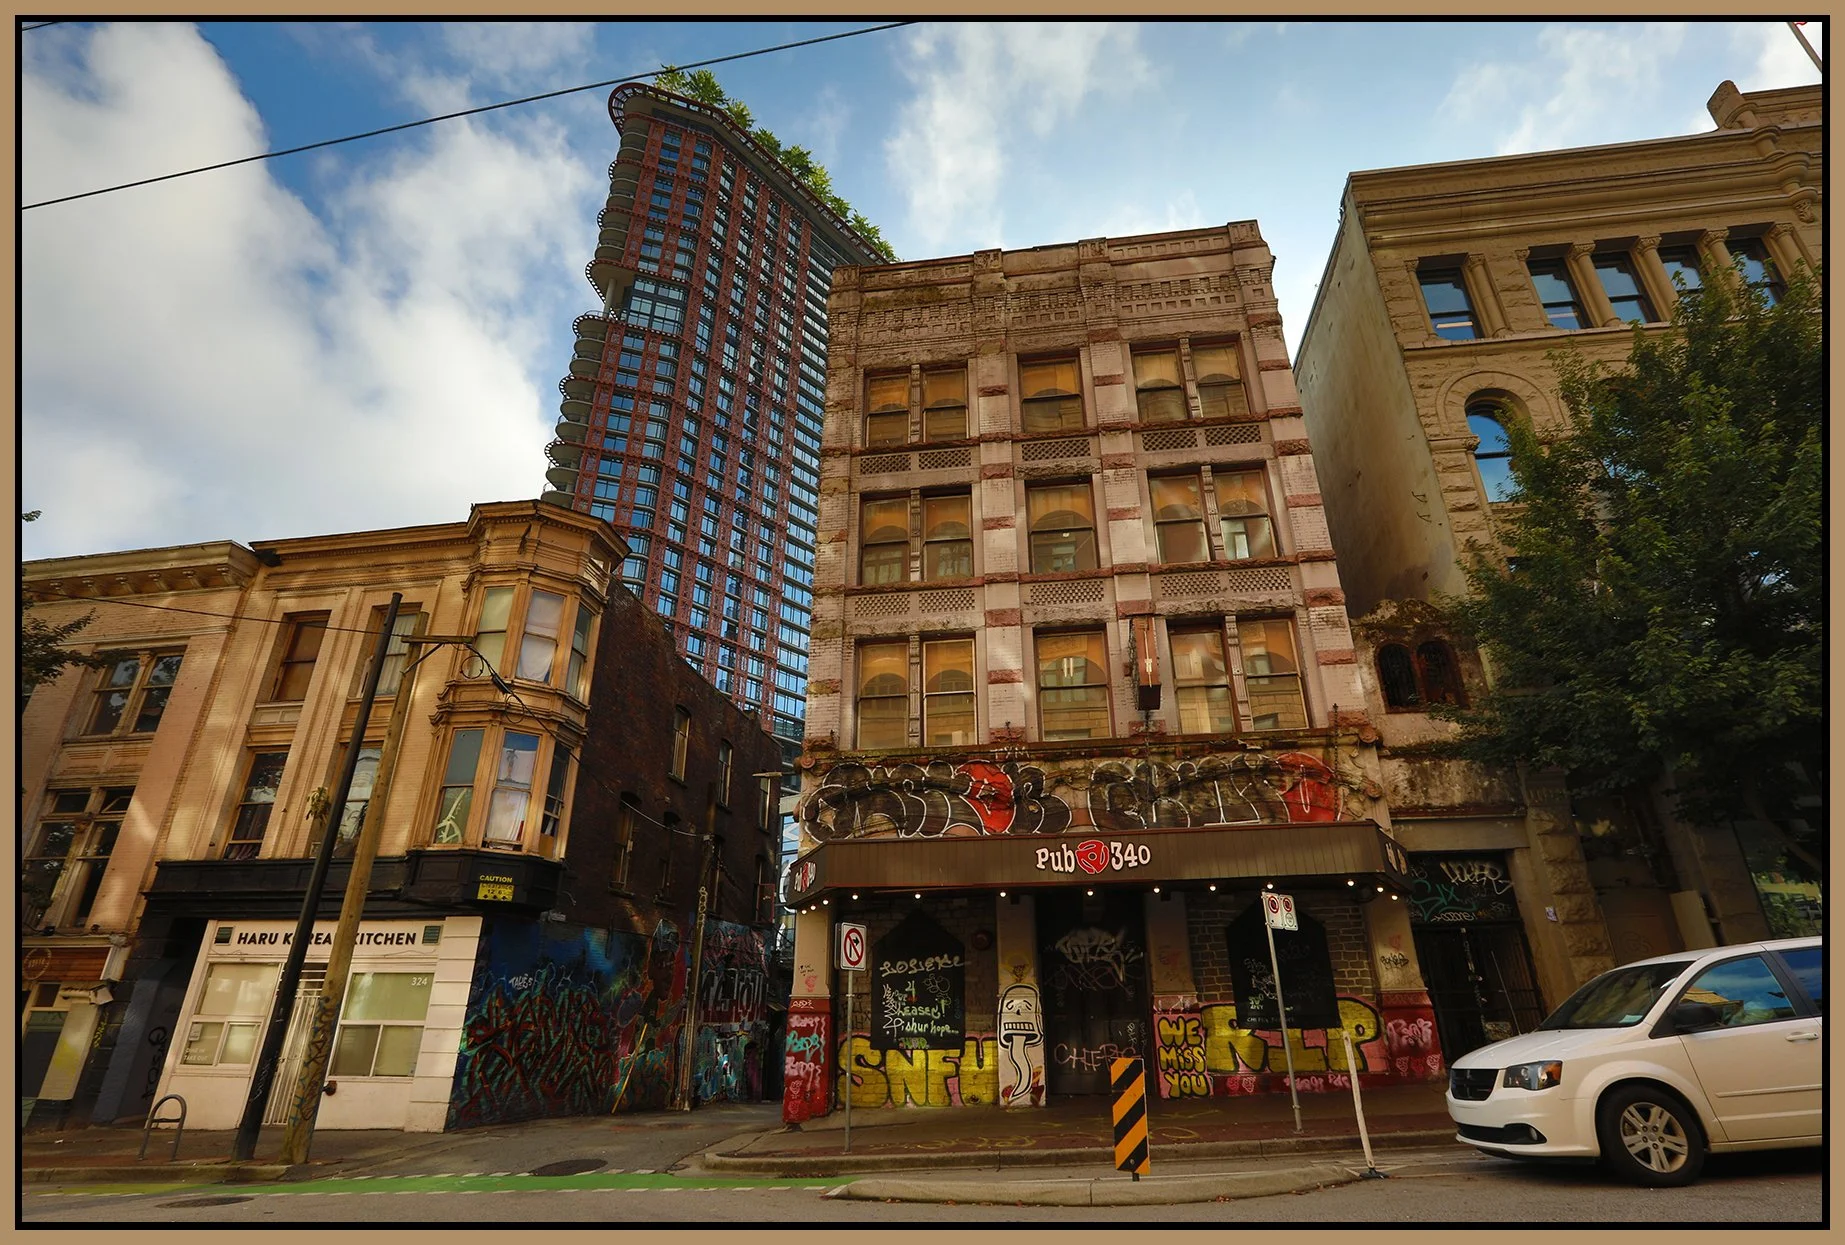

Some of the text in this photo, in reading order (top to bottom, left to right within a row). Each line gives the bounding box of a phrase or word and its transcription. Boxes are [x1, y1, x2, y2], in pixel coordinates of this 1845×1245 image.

[1035, 841, 1151, 873] Pub 340
[479, 874, 513, 883] CAUTION
[237, 932, 280, 945] HARU
[411, 976, 429, 986] 324
[1158, 1015, 1203, 1047] WE
[837, 1035, 999, 1108] SNFU
[1163, 1071, 1209, 1098] YOU
